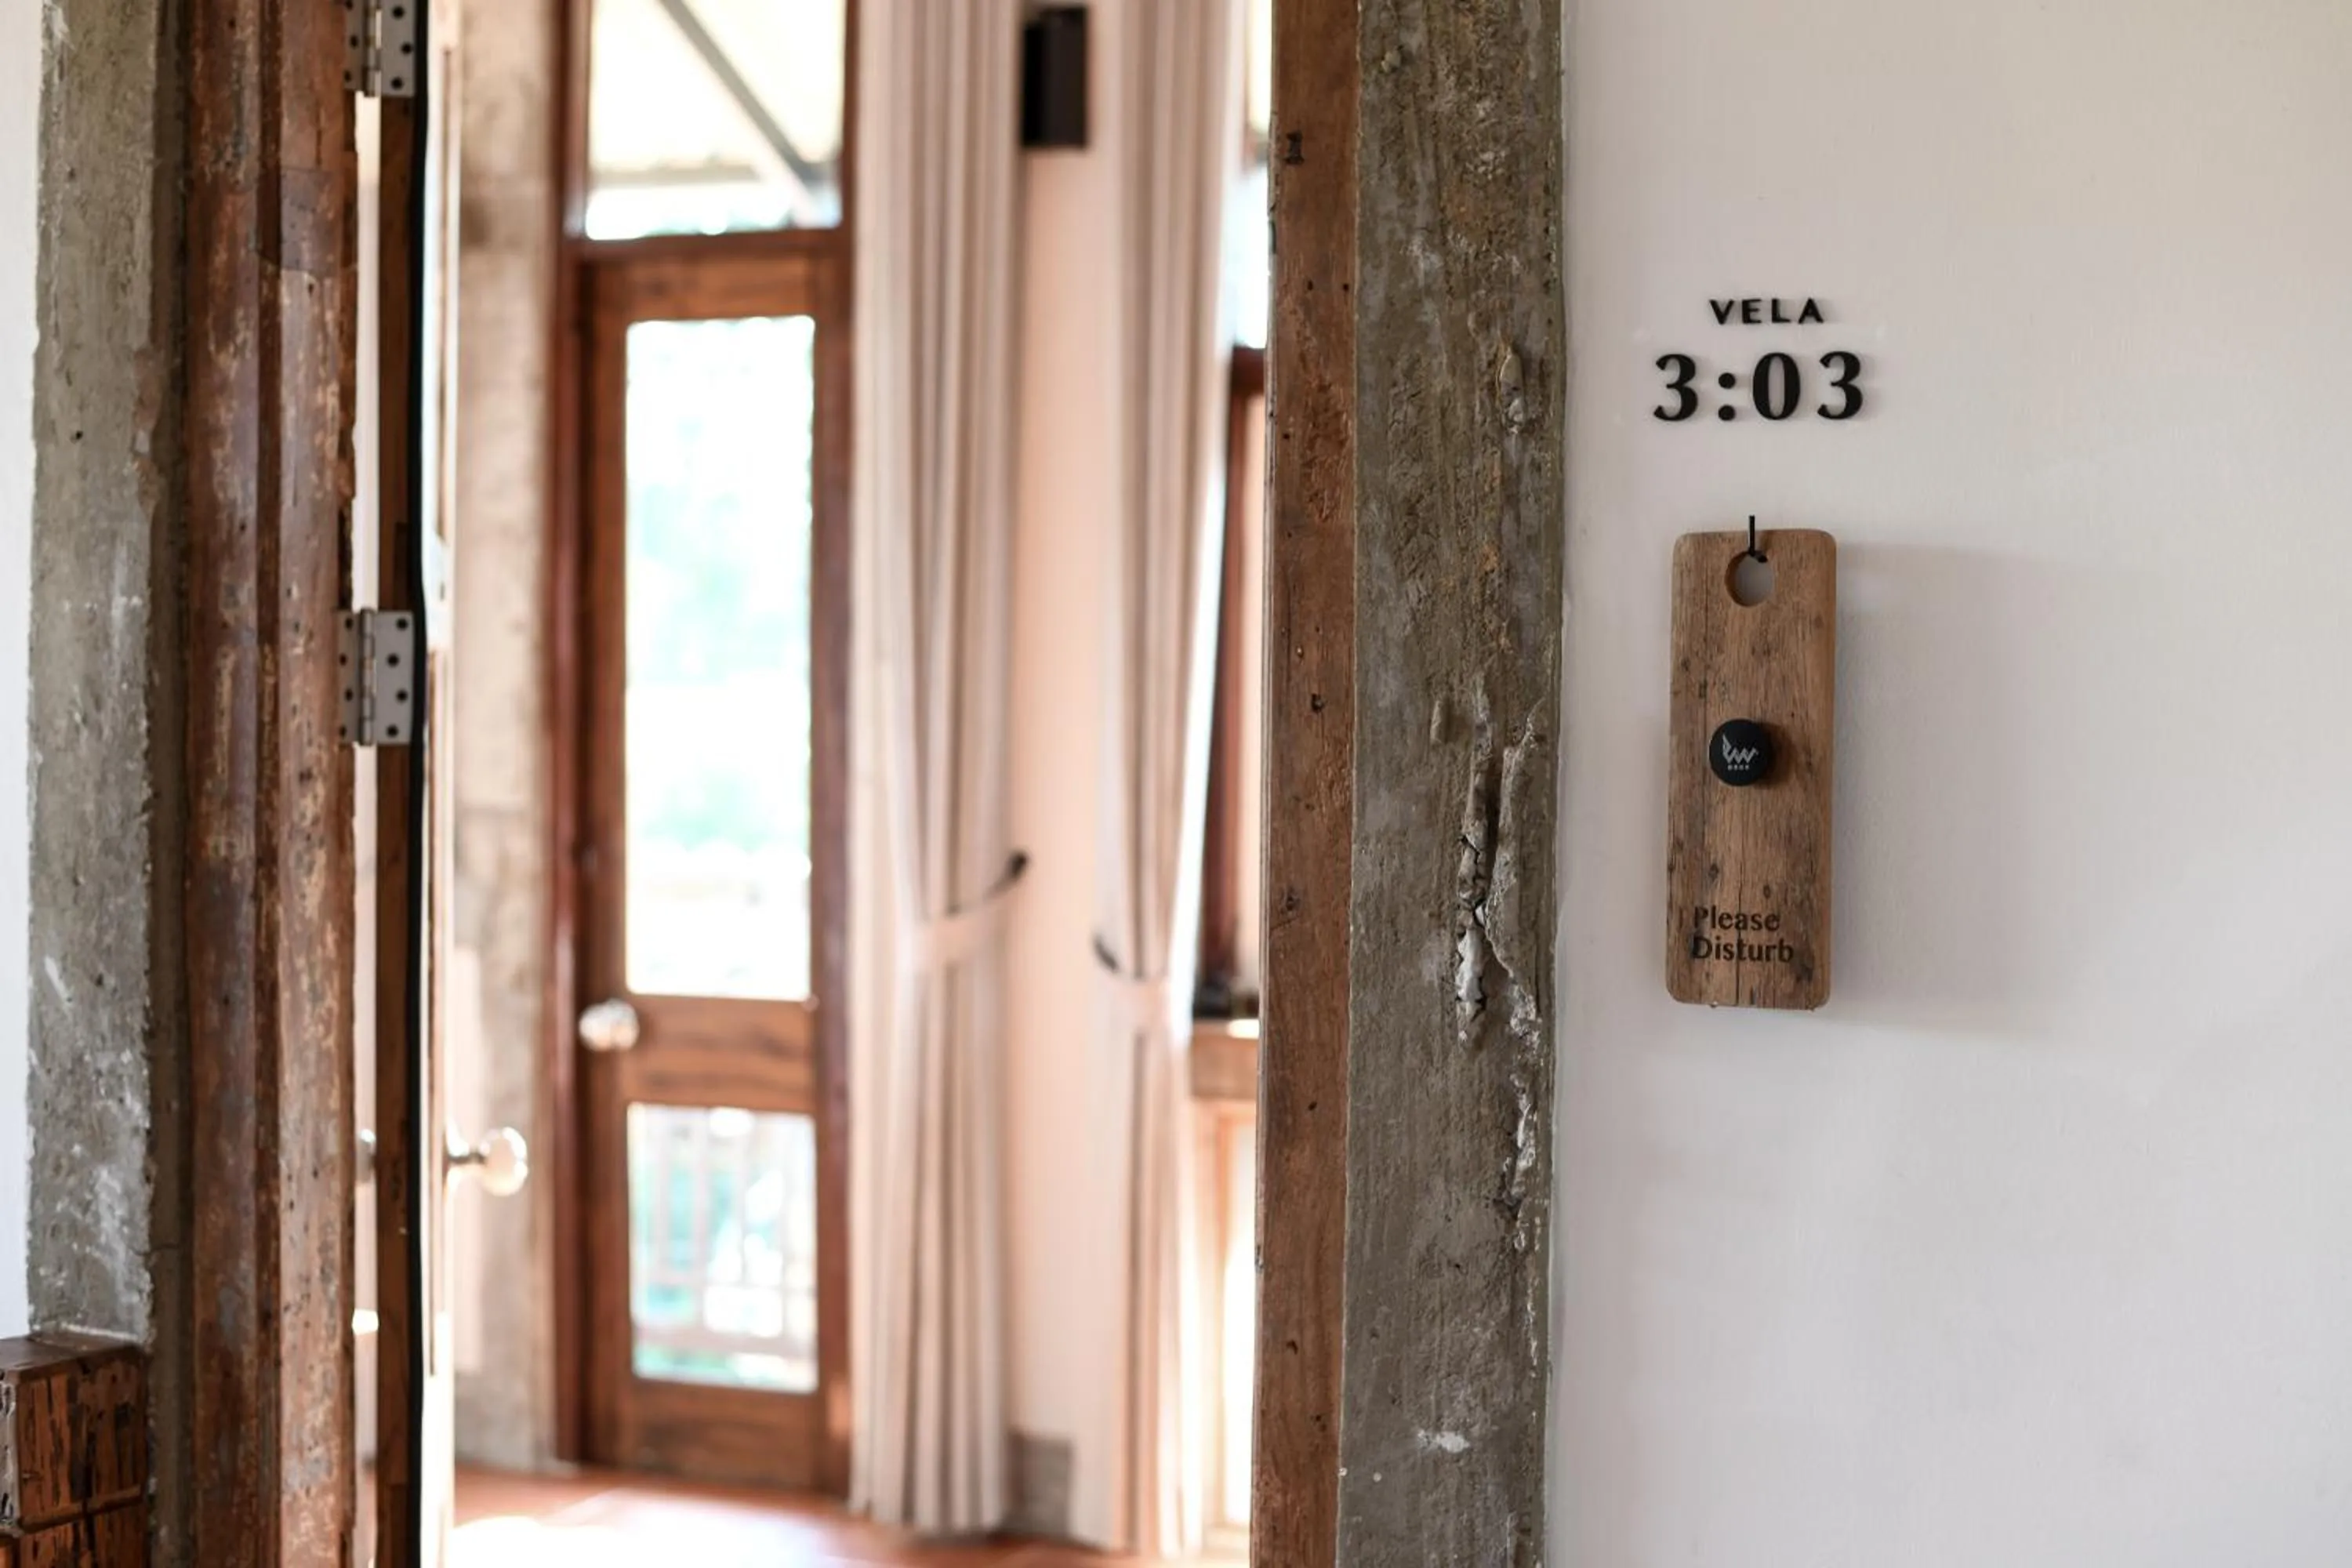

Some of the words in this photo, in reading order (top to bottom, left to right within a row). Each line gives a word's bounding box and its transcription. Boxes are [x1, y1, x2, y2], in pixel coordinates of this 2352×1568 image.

[1709, 297, 1824, 325] VELA
[1653, 351, 1864, 421] 3:03
[1694, 905, 1780, 931] Please
[1692, 935, 1794, 963] Disturb
